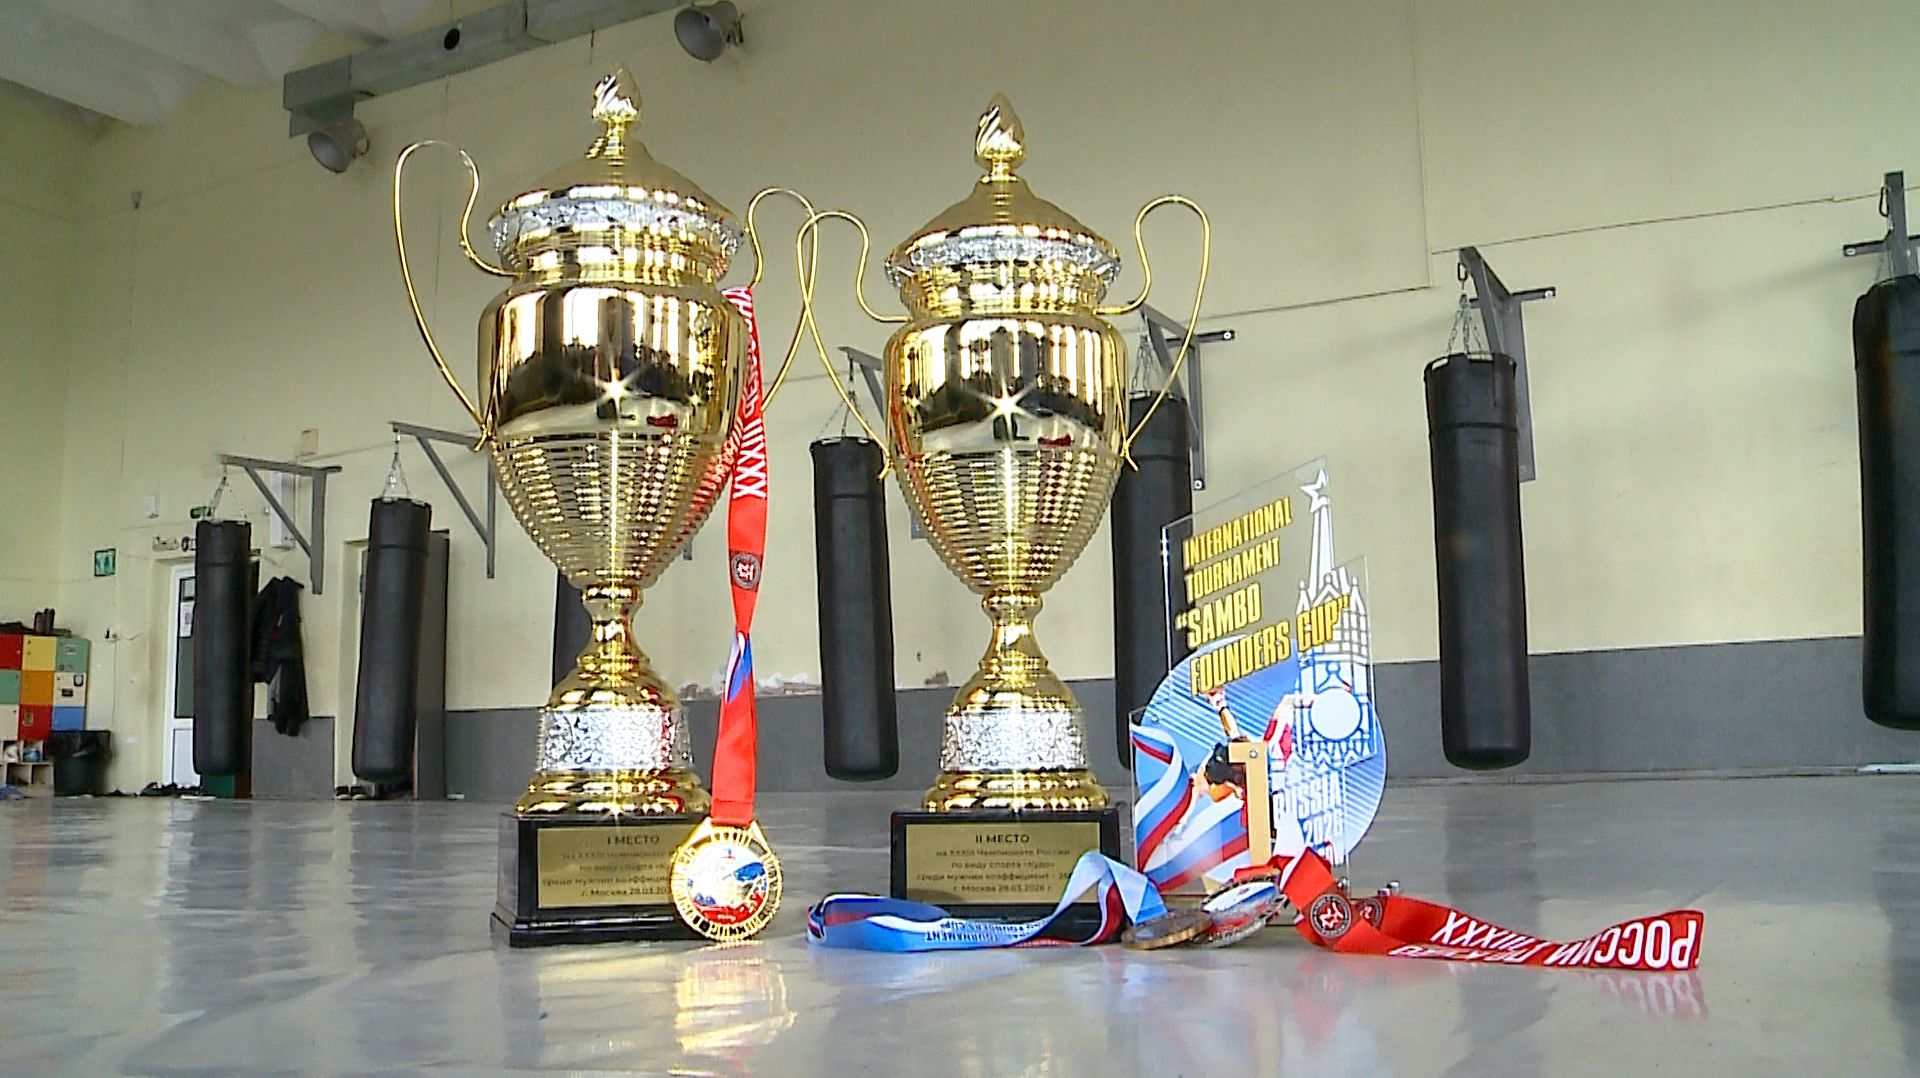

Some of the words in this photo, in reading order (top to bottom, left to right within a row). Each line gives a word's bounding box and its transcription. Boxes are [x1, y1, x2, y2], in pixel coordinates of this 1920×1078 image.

[732, 418, 767, 499] XXXIII
[1183, 496, 1293, 569] INTERNATIONAL
[1185, 537, 1280, 603] TOURNAMENT
[1190, 620, 1292, 697] FOUNDERS
[1272, 771, 1344, 830] RUSSIA
[614, 834, 660, 845] МЕСТО
[975, 834, 984, 843] II
[986, 834, 1030, 844] МЕСТО
[961, 885, 996, 893] Москва
[1543, 919, 1698, 969] РОССИИ
